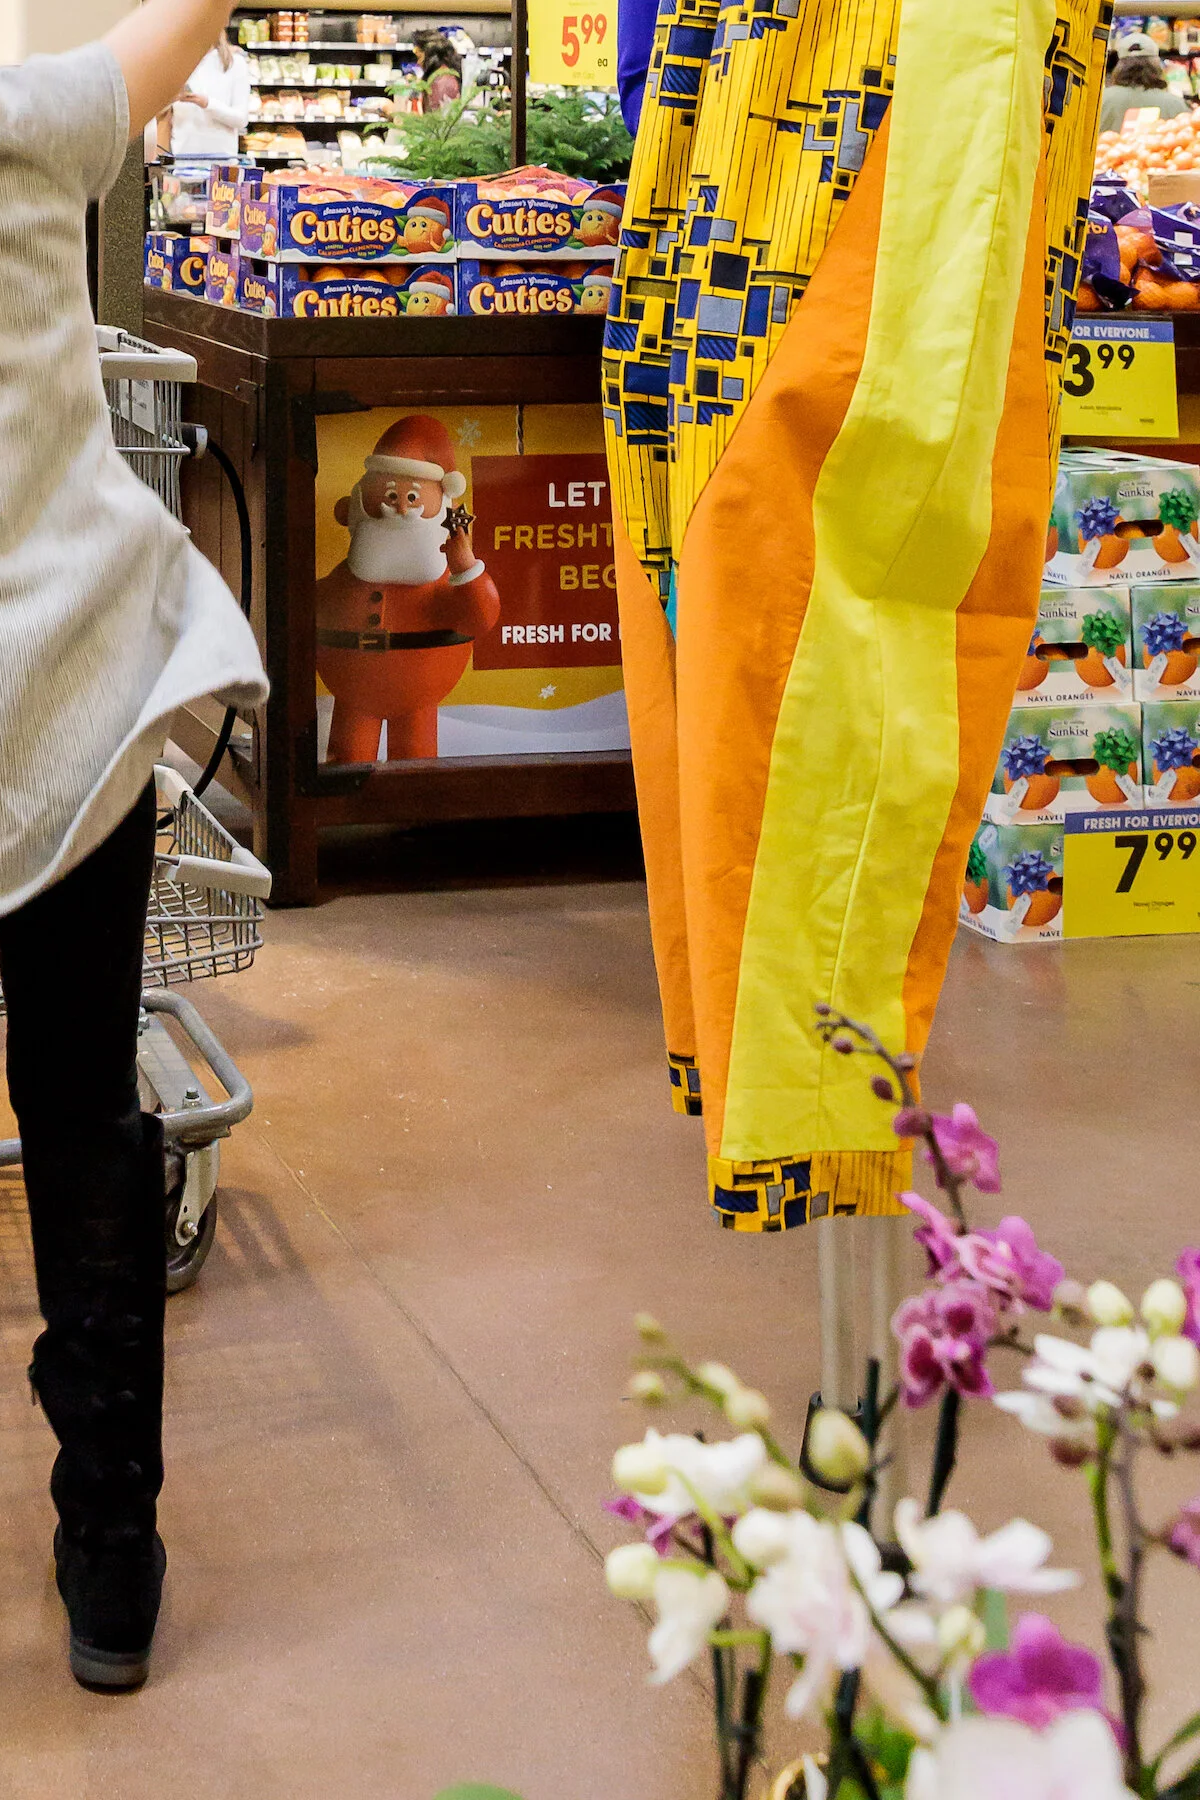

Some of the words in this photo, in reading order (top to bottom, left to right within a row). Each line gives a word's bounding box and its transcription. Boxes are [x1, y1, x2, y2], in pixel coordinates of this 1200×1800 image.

[597, 57, 608, 67] ea
[211, 181, 235, 202] Cuties
[244, 204, 267, 226] Cuties
[466, 203, 572, 238] Cuties
[290, 210, 397, 245] Cuties
[210, 255, 229, 278] Cuties
[244, 277, 266, 300] Cuties
[469, 282, 573, 315] Cuties
[292, 289, 398, 317] Cuties
[1072, 325, 1091, 337] OR
[548, 481, 606, 508] LET
[1118, 487, 1154, 498] Sunkist
[494, 523, 614, 550] FRESHT
[560, 564, 617, 591] BEG
[1135, 570, 1171, 578] ORANGES
[1039, 607, 1077, 619] Sunkist
[502, 624, 564, 644] FRESH
[572, 623, 612, 642] FOR
[1056, 693, 1094, 701] ORANGES
[1049, 726, 1089, 737] Sunkist
[1084, 816, 1121, 830] FRESH
[1124, 815, 1149, 828] FOR
[1152, 813, 1200, 827] EVERYO
